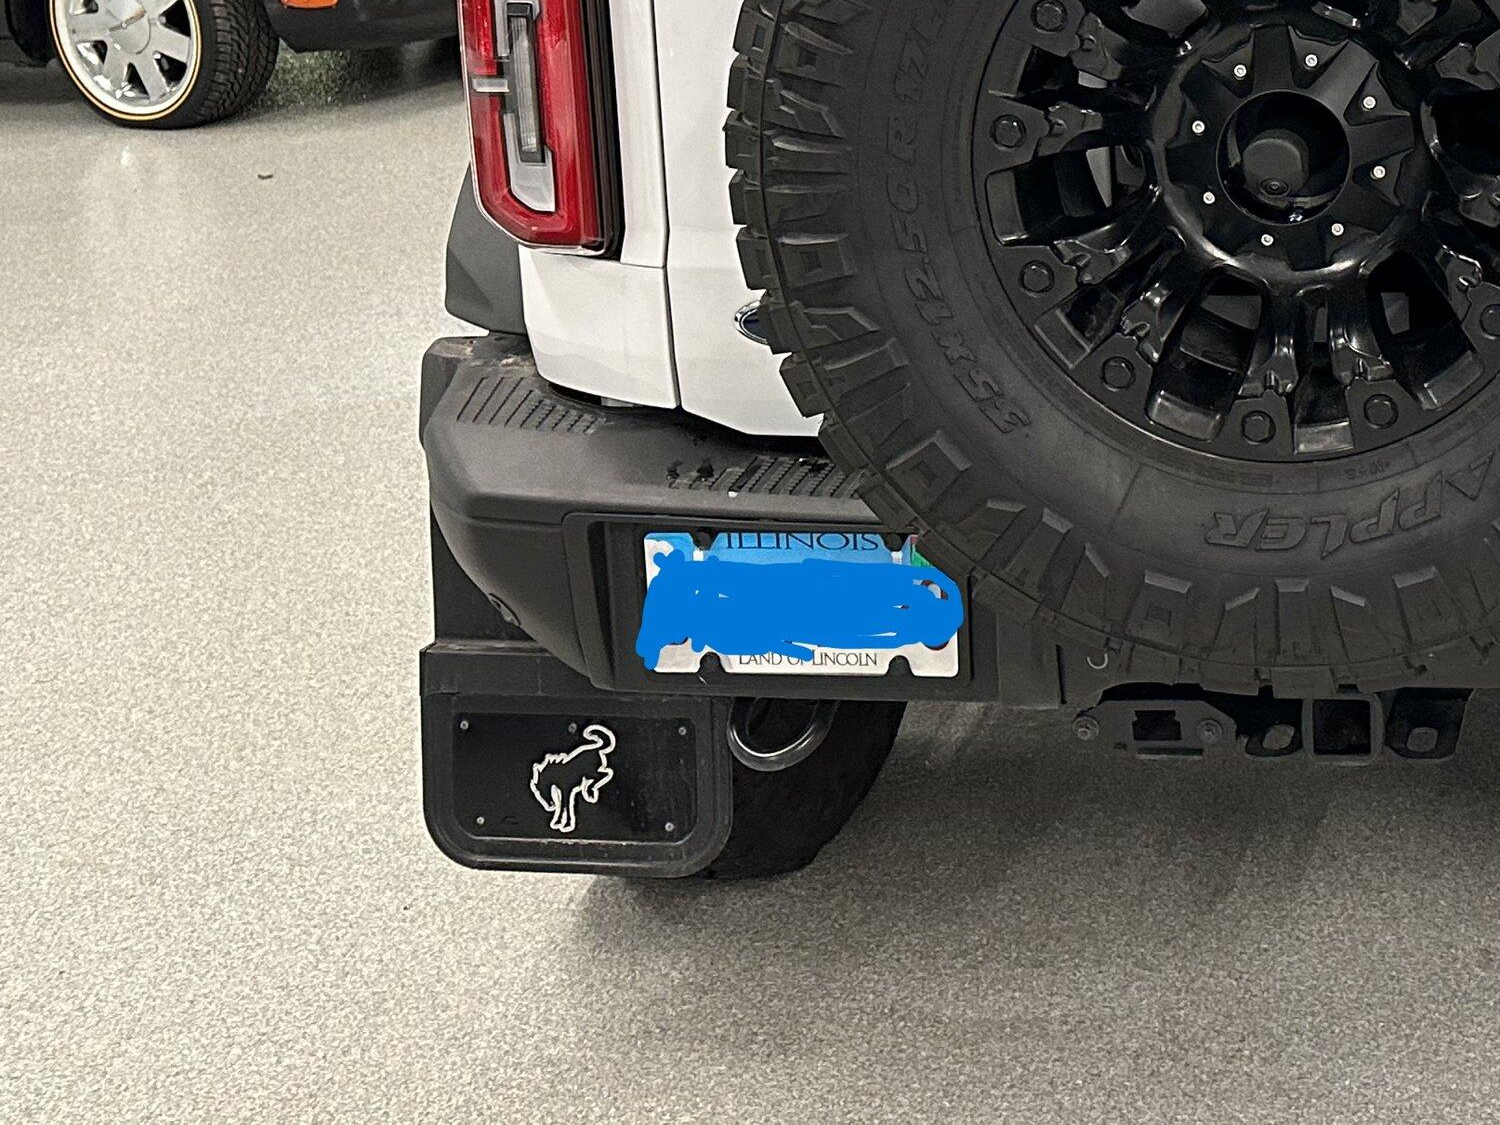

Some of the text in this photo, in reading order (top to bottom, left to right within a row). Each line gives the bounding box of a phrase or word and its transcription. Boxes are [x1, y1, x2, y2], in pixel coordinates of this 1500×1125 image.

[727, 532, 879, 550] ILLINOIS
[738, 652, 783, 667] LAND
[812, 652, 878, 668] LINCOLN
